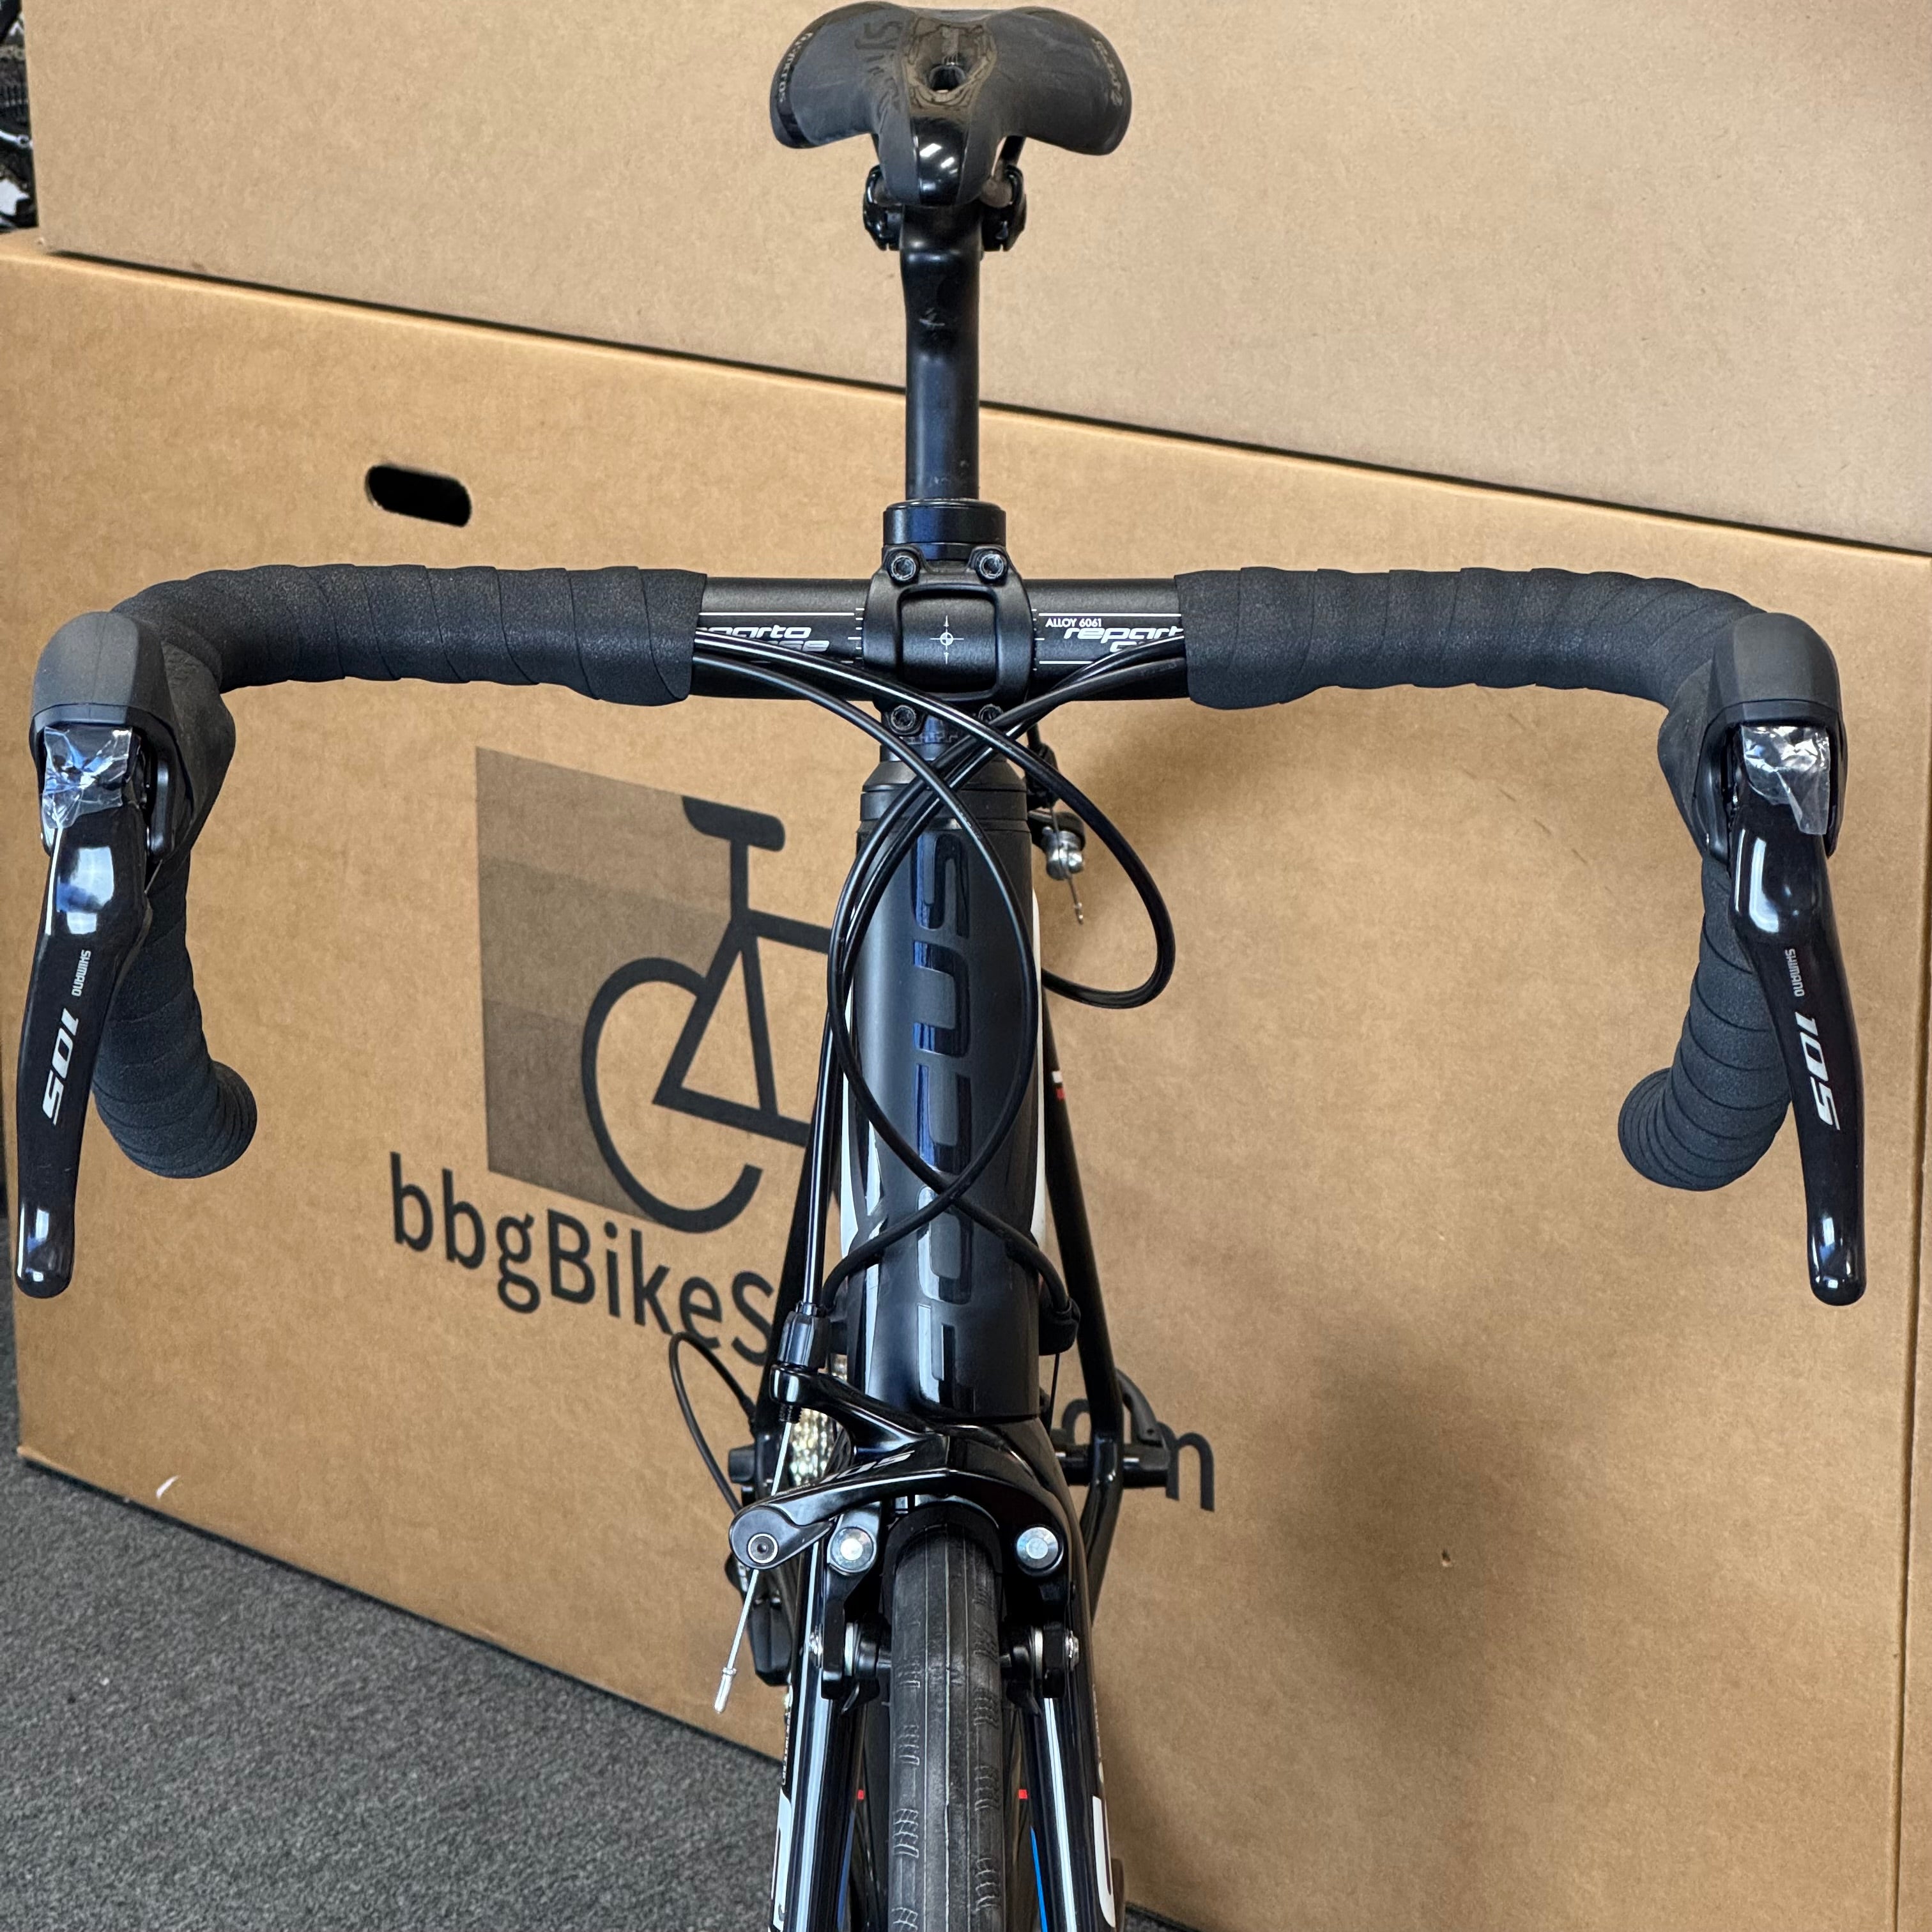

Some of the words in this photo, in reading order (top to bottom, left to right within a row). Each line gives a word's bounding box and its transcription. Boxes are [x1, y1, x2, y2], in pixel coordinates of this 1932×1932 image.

[1045, 618, 1077, 627] ALLOY
[1079, 618, 1102, 627] 6061
[72, 949, 91, 997] SHIMANO
[1784, 948, 1805, 997] SHIMANO
[42, 1008, 79, 1126] 105
[1795, 1011, 1840, 1131] 105
